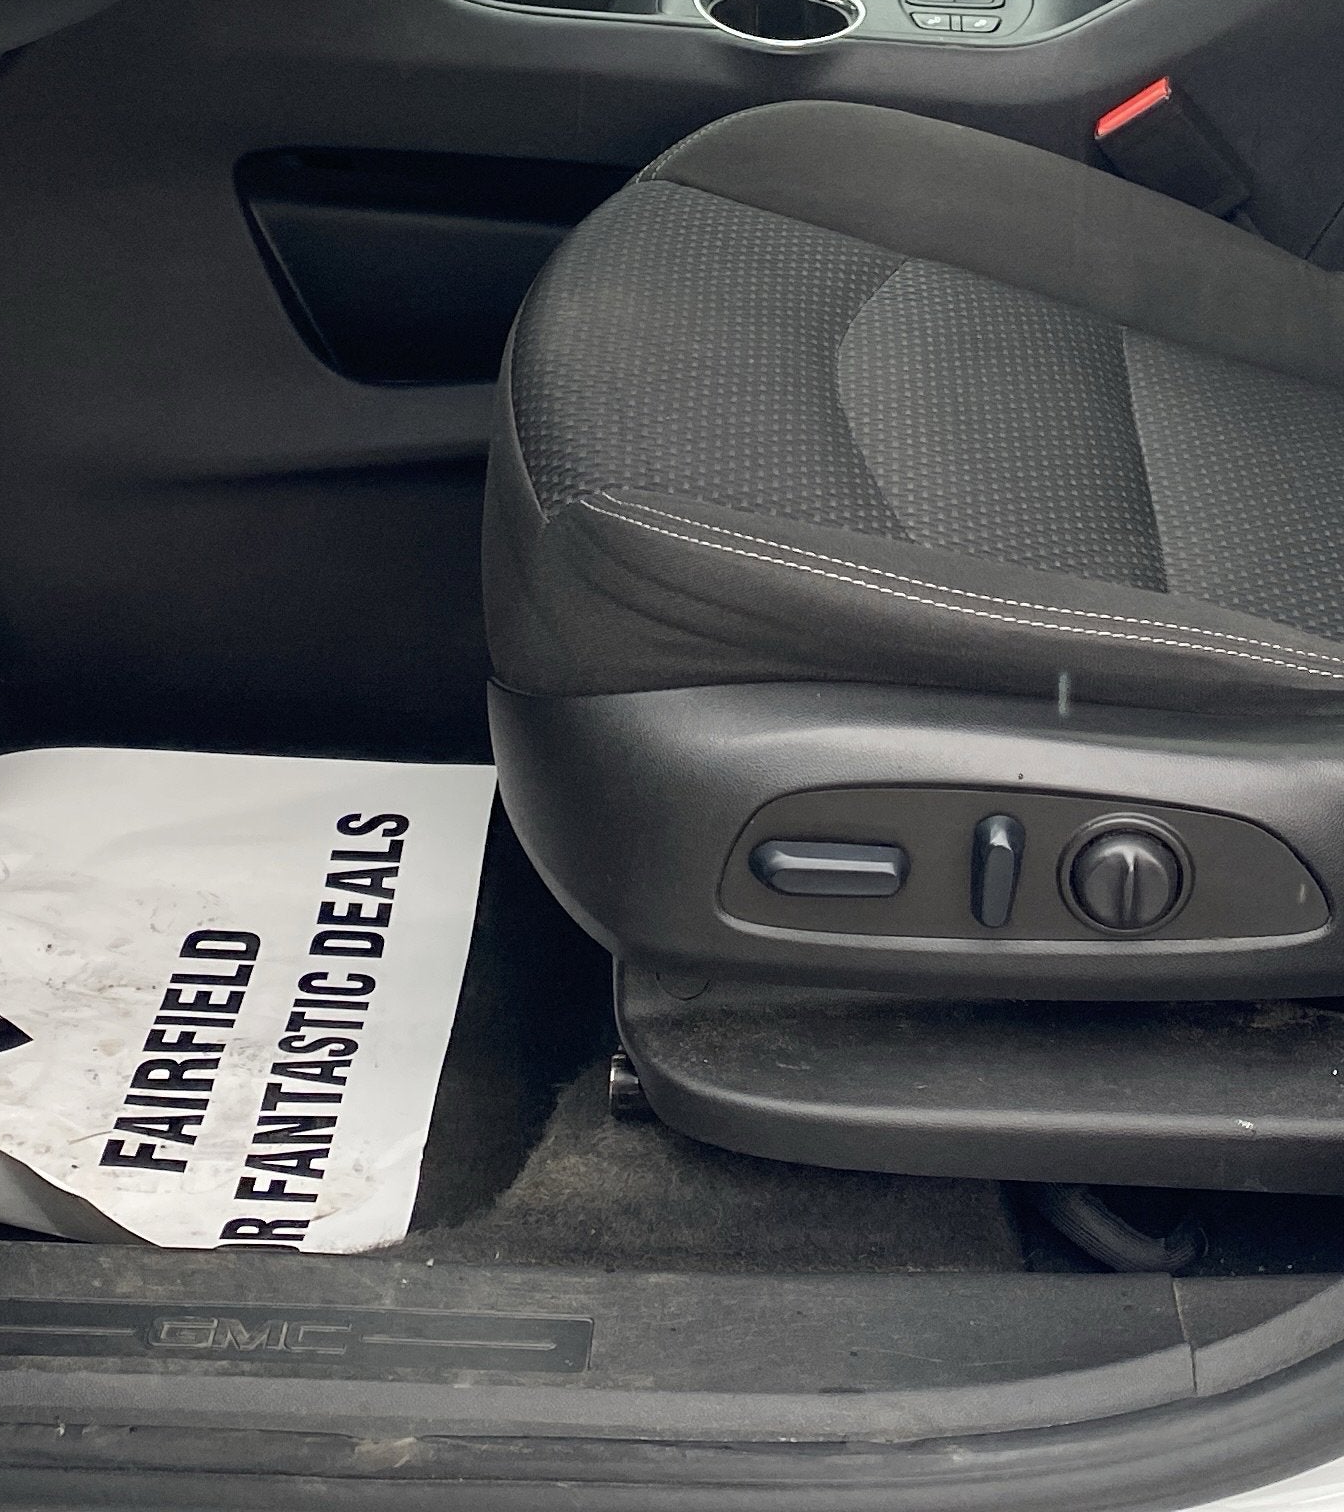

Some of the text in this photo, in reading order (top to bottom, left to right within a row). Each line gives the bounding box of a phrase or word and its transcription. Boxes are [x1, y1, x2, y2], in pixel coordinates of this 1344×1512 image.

[98, 928, 262, 1174] FAIRFIELD
[233, 970, 377, 1203] FANTASTIC
[308, 812, 410, 959] DEALS
[148, 1317, 353, 1354] GMC
